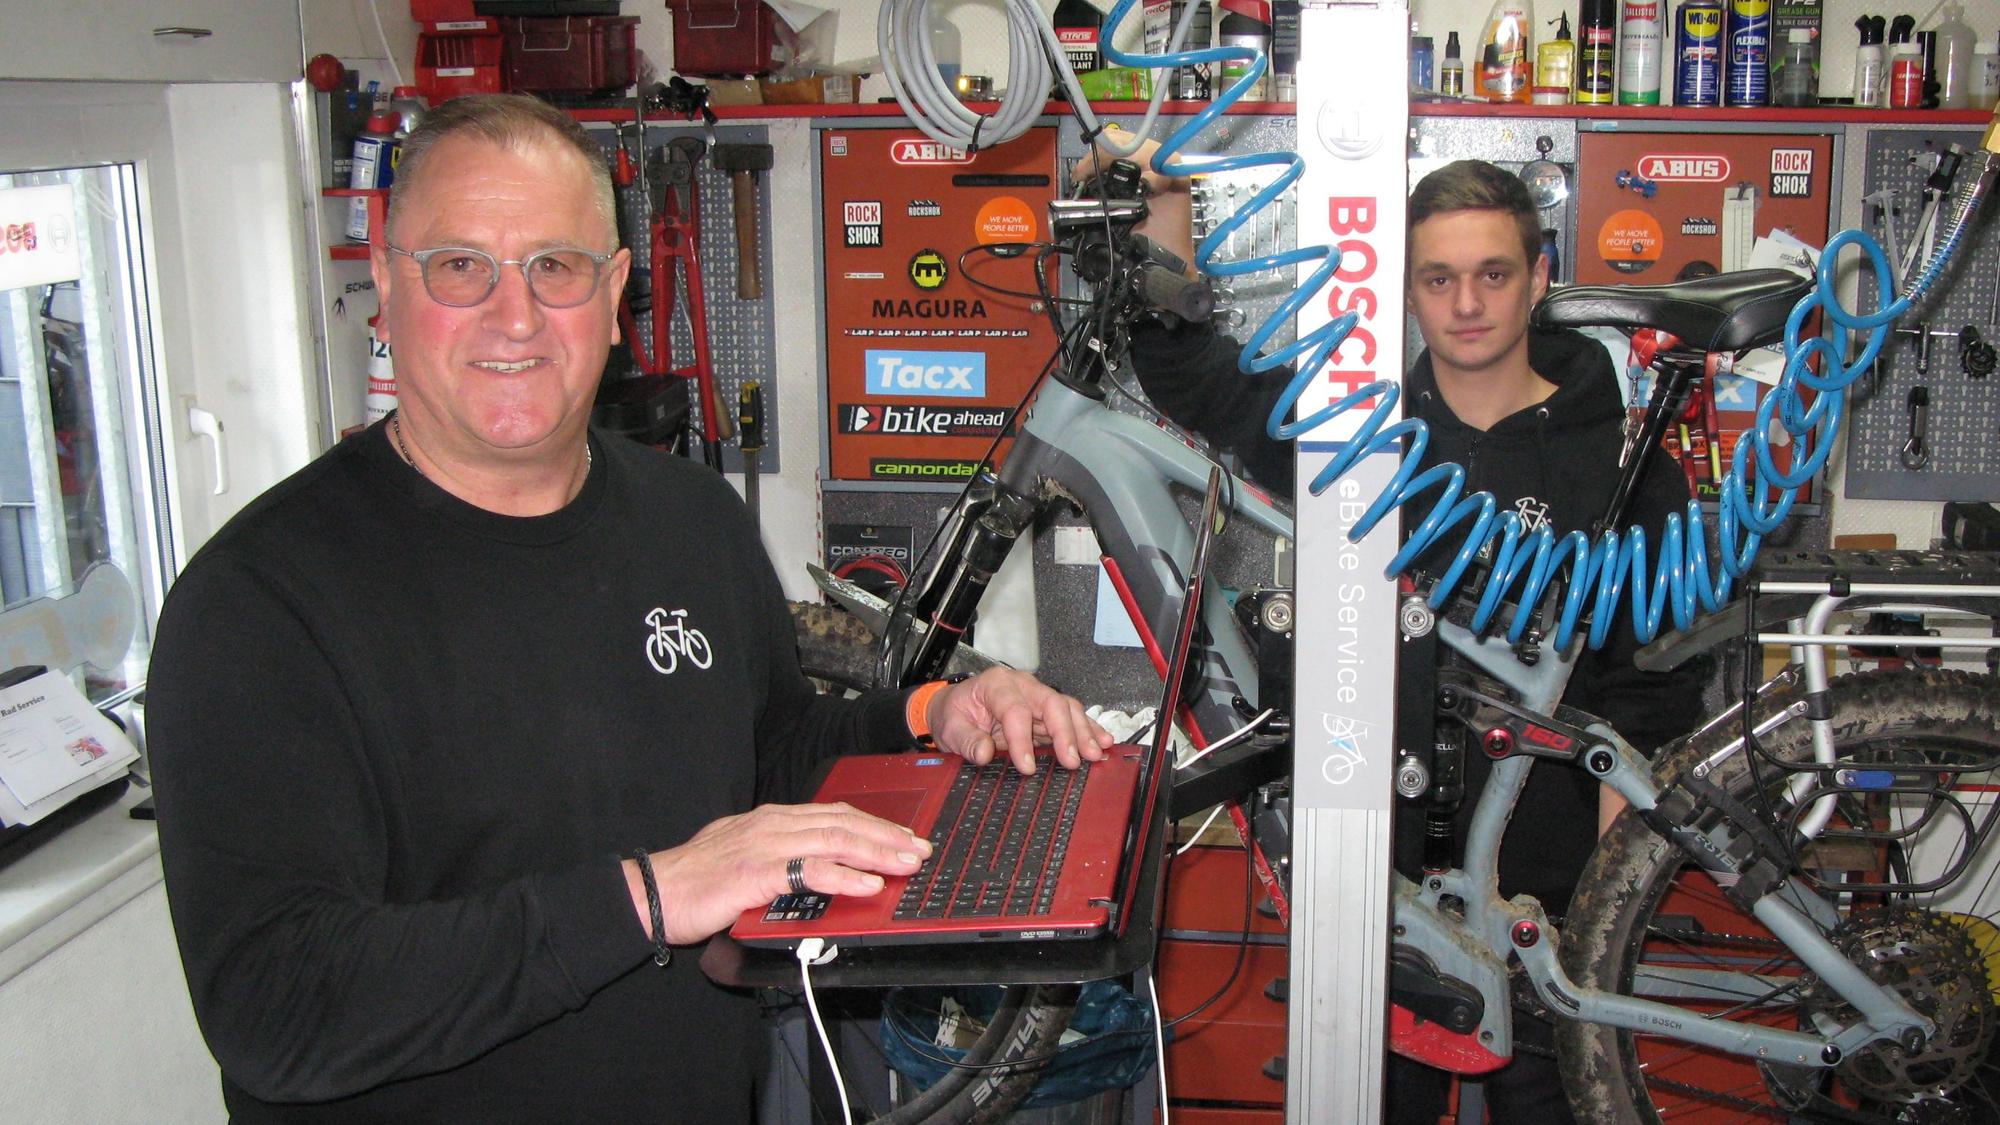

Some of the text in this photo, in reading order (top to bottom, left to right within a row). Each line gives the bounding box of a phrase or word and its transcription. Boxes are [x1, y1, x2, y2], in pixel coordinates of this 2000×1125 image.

[1688, 12, 1719, 25] WD-40
[902, 144, 967, 160] ABUS
[1649, 160, 1720, 178] ABUS
[1774, 153, 1809, 171] ROCK
[1773, 175, 1808, 195] SHOX
[847, 205, 878, 222] ROCK
[1002, 216, 1023, 224] MOVE
[847, 227, 880, 245] SHOX
[983, 224, 1006, 232] PEOPLE
[1627, 230, 1649, 238] MOVE
[871, 300, 988, 318] MAGURA
[1328, 196, 1378, 411] BOSCH
[877, 356, 974, 390] Tacx
[882, 407, 1004, 434] bike ahead
[1336, 583, 1366, 704] Service
[1521, 722, 1574, 751] 160
[1651, 1016, 1683, 1030] BOSCH
